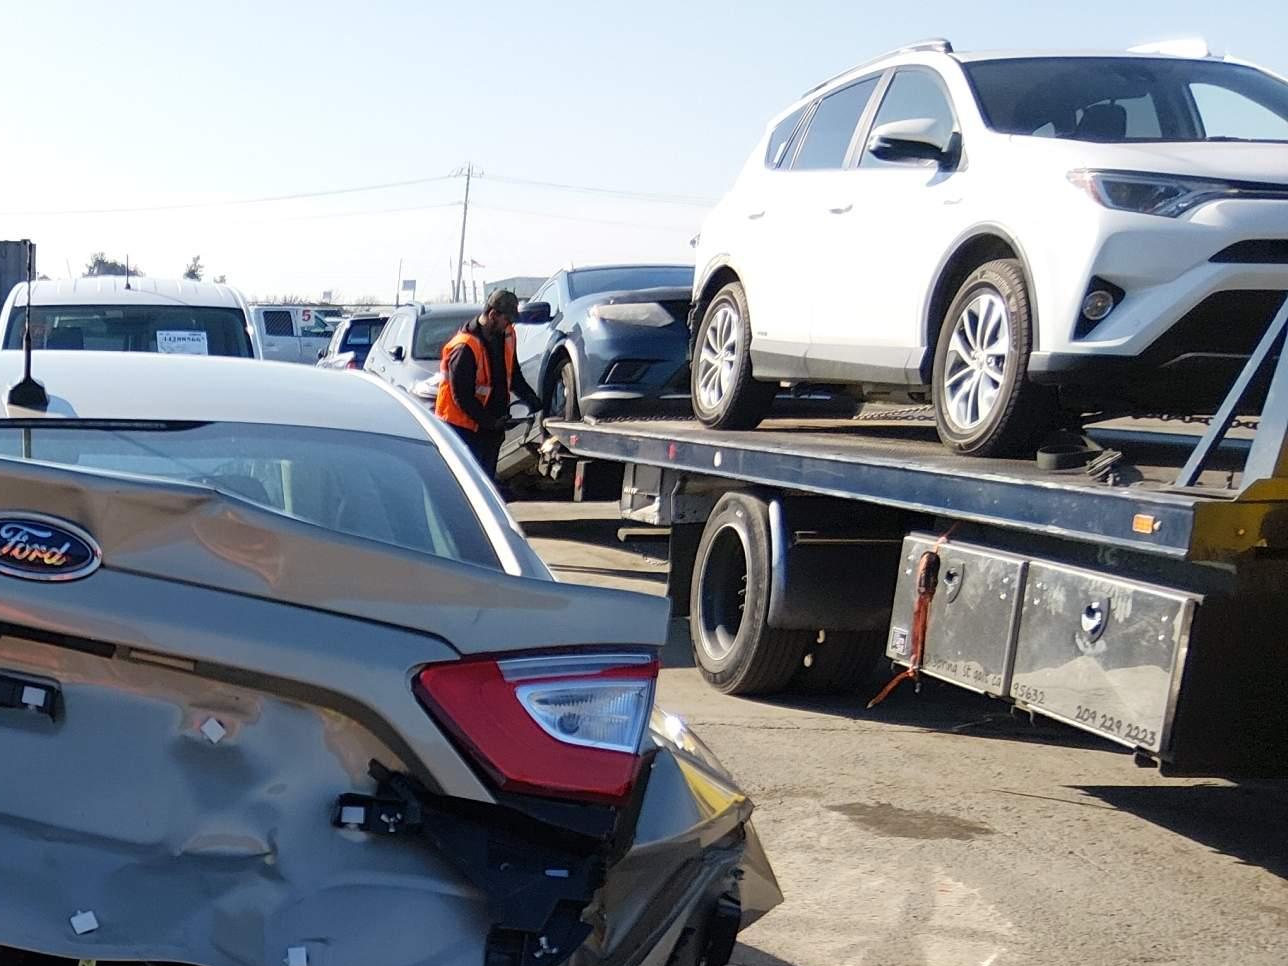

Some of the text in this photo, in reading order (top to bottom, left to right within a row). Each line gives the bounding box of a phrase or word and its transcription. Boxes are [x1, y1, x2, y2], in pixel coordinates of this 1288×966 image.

[302, 309, 311, 321] 5
[1013, 682, 1045, 705] 95632
[1075, 705, 1157, 747] 209 229 2223
